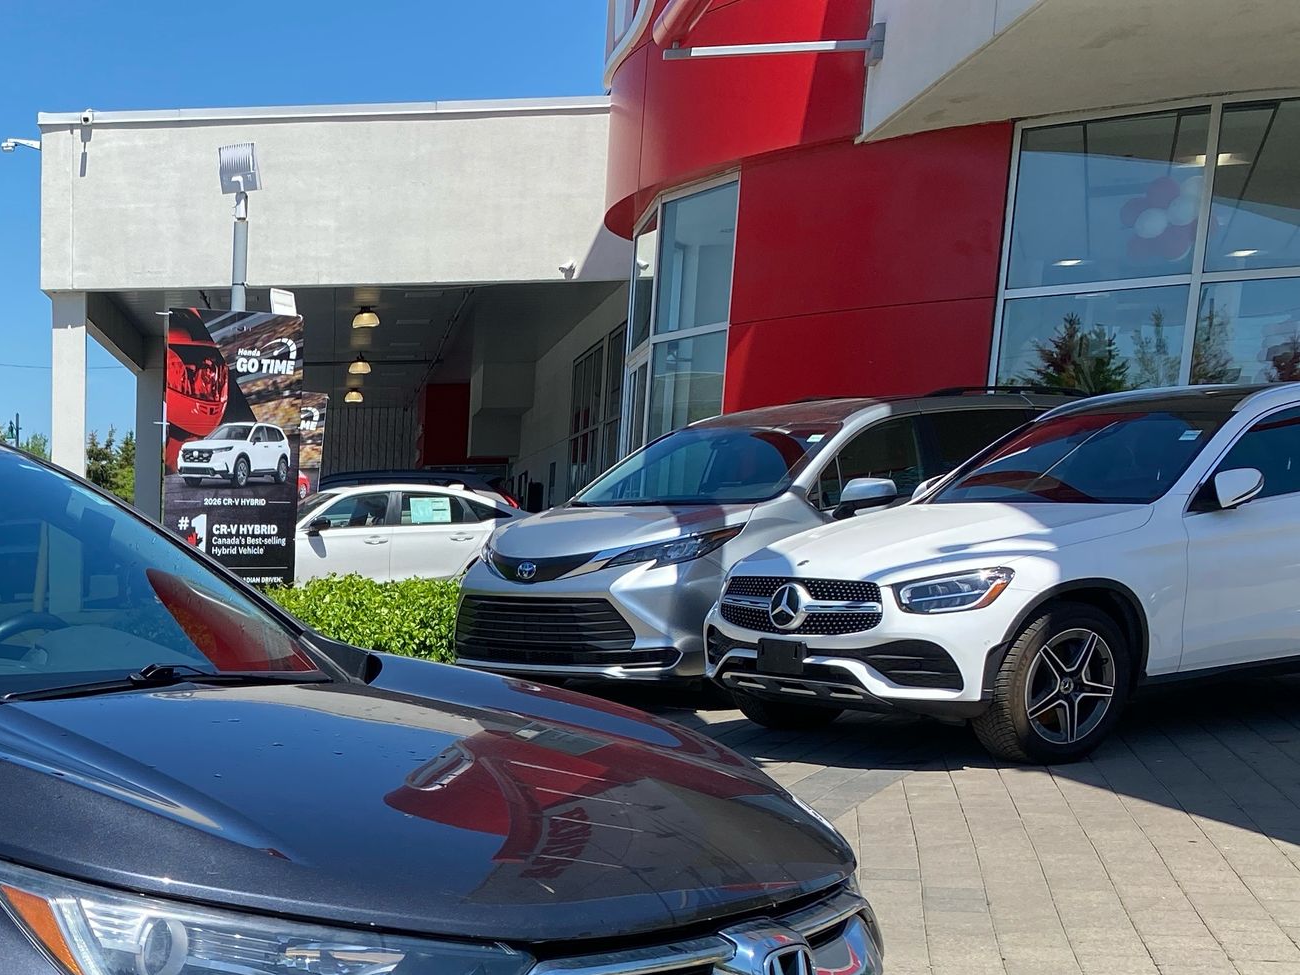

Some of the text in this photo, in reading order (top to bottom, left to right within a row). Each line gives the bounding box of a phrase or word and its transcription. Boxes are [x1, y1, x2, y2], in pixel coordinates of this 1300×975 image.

[237, 348, 261, 357] Honda
[236, 357, 296, 375] GO TIME
[203, 498, 267, 506] 2026 CR-V HYBRID
[212, 524, 278, 535] CR-V HYBRID
[211, 536, 287, 547] Canada's Best-selling
[211, 546, 238, 556] Hybrid
